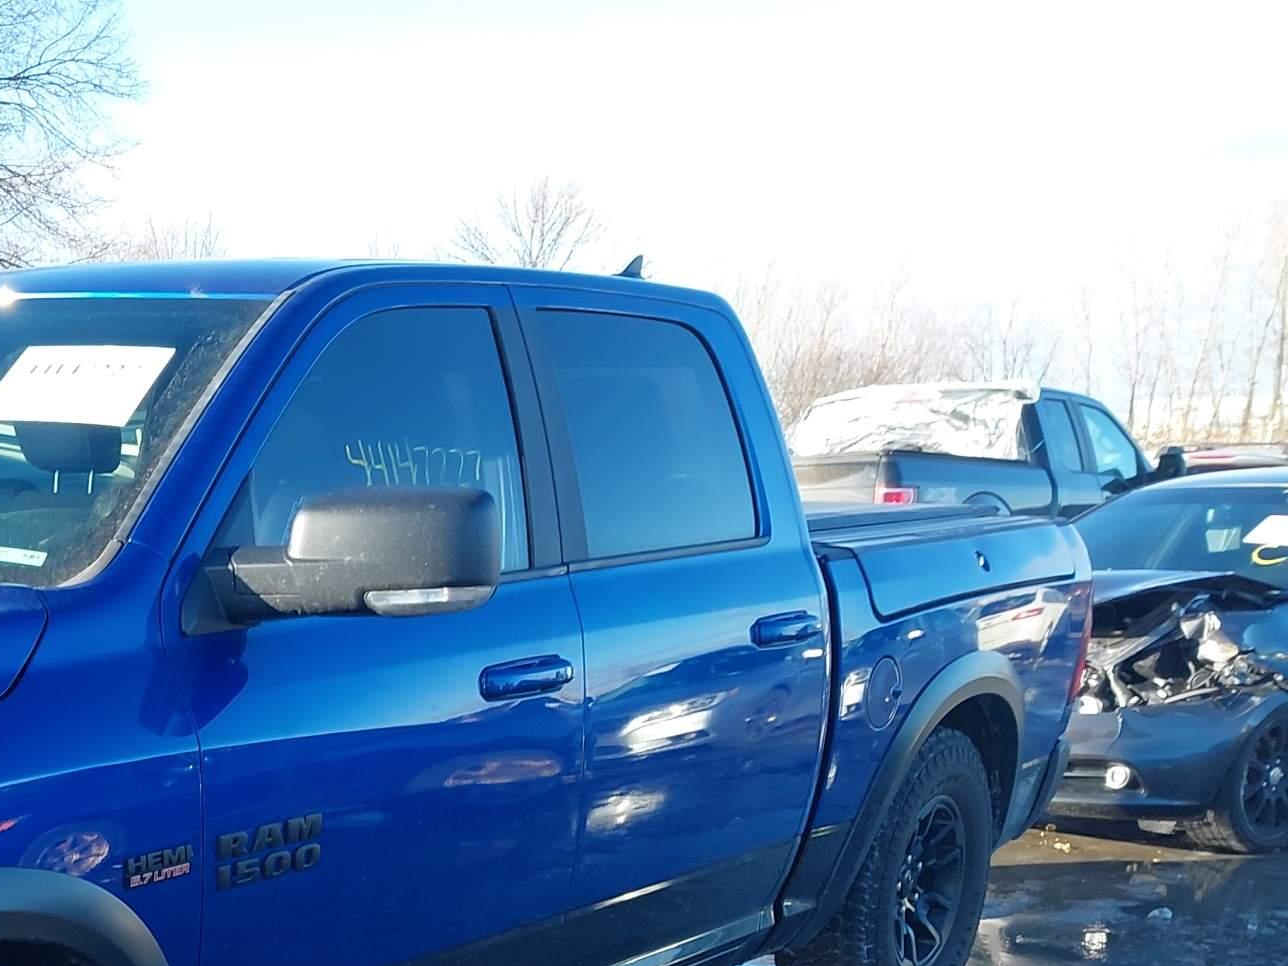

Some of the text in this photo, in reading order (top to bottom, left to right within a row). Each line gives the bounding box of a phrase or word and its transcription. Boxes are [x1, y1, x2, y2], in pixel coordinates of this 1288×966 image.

[217, 813, 323, 861] RAM
[127, 845, 194, 876] HEMI
[153, 862, 191, 882] LITER
[216, 843, 322, 893] 1500
